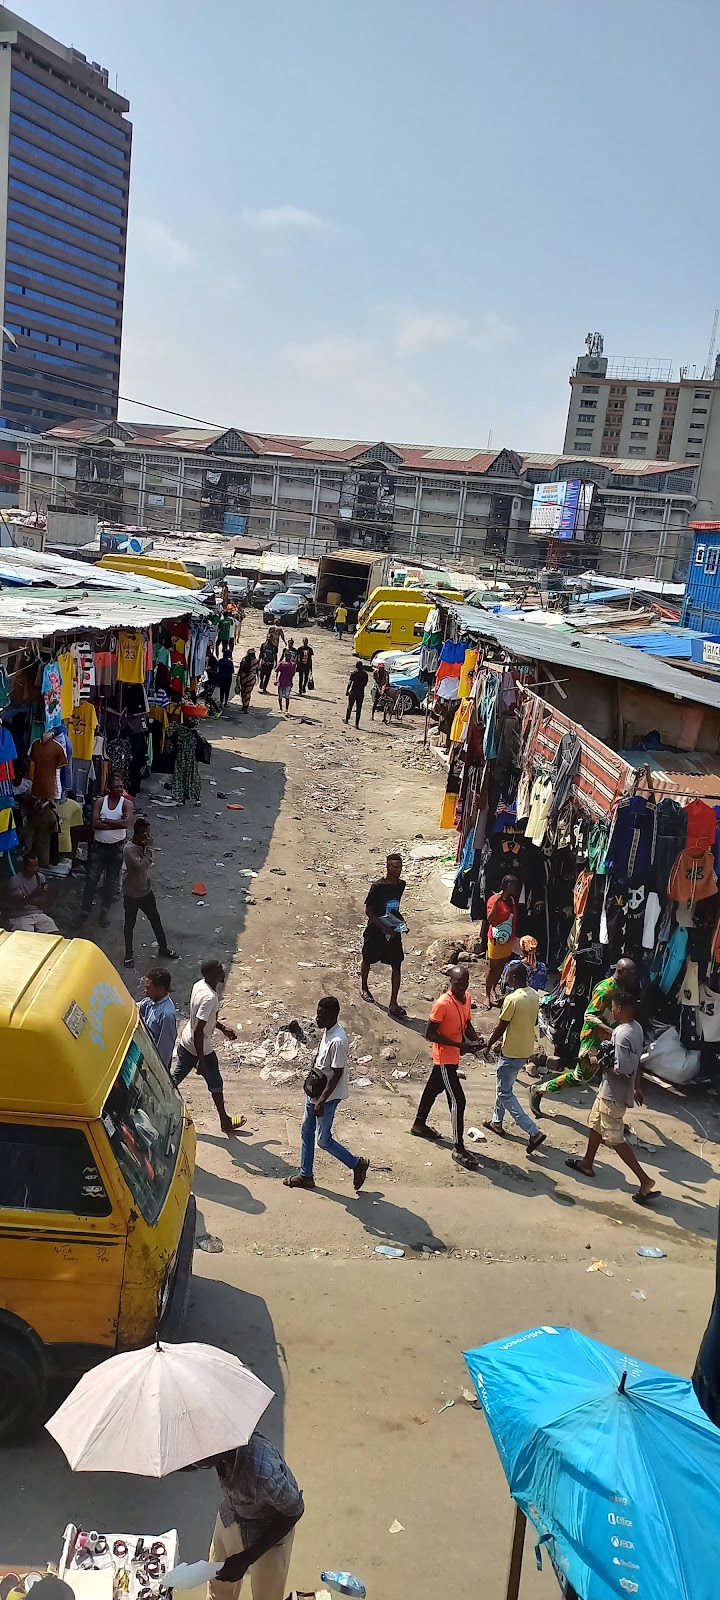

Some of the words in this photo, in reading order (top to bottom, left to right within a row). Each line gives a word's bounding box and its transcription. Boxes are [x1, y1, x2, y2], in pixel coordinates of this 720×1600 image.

[125, 651, 136, 660] 23
[498, 1329, 544, 1350] Microsoft
[616, 1515, 633, 1527] Office
